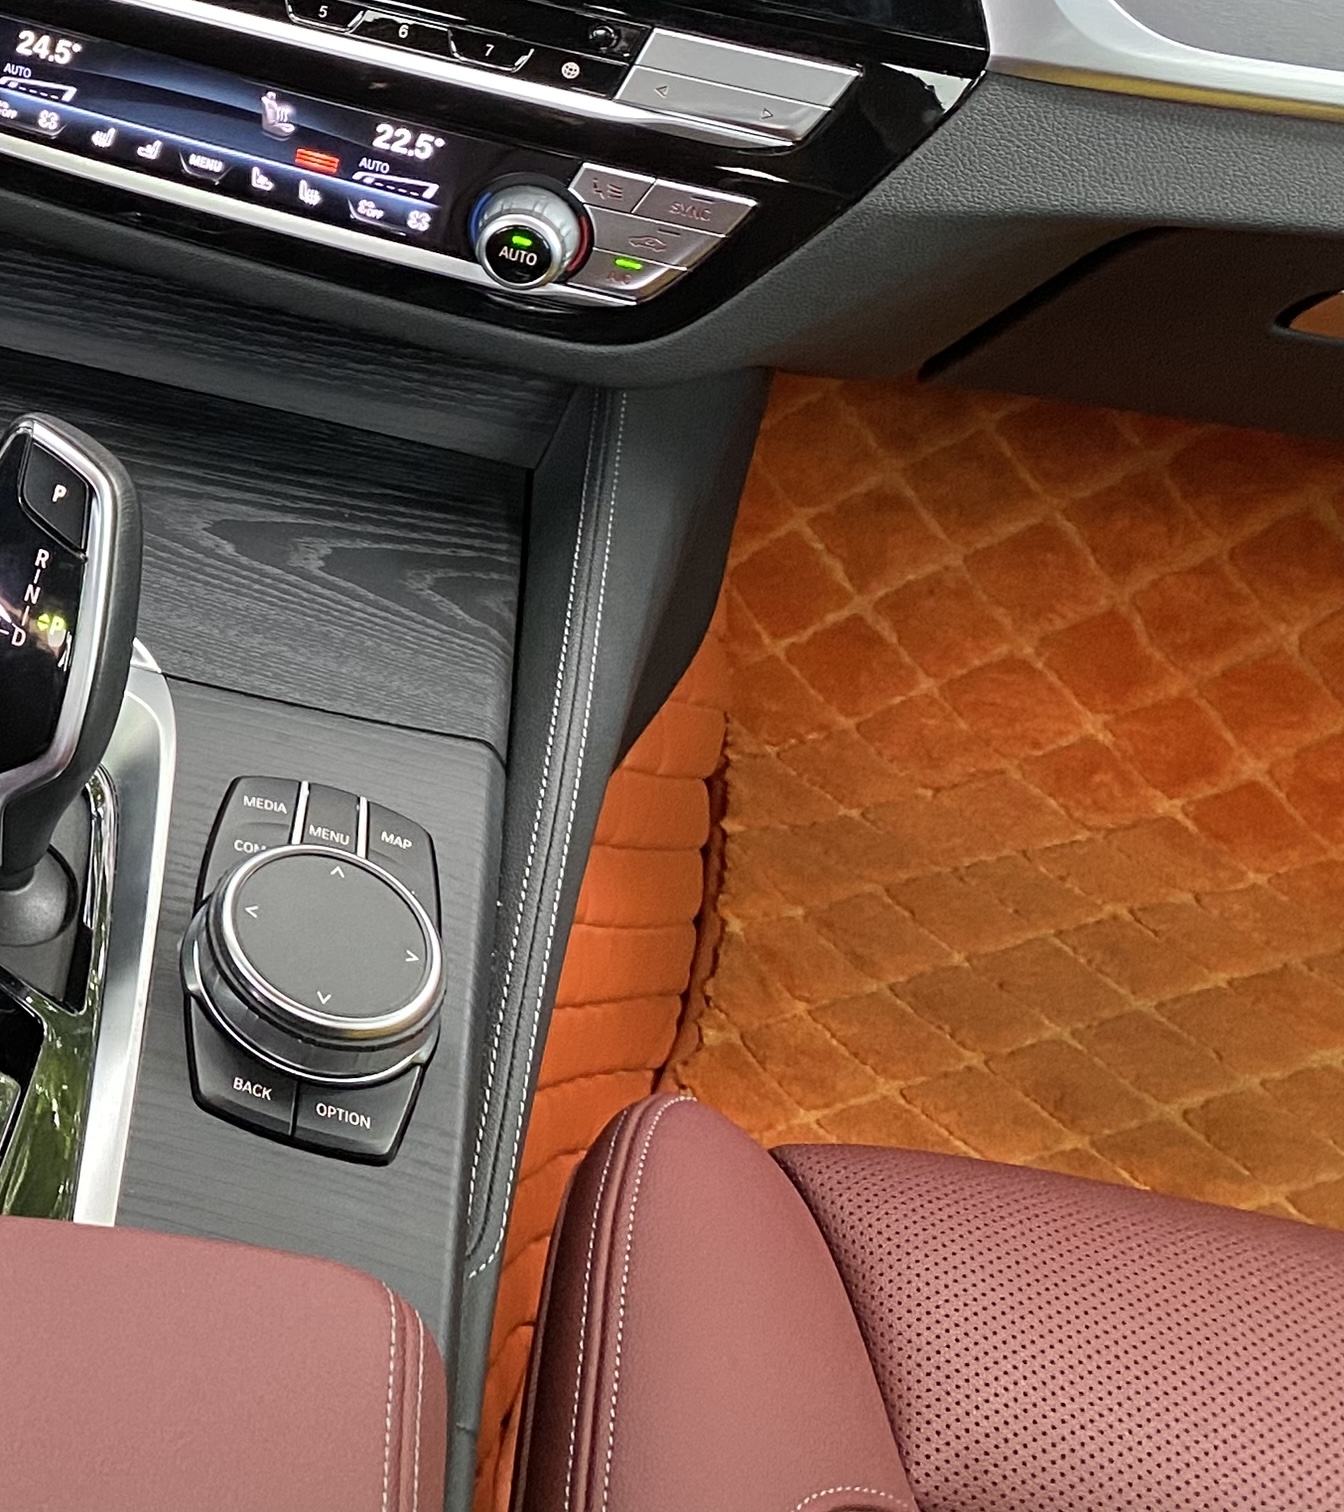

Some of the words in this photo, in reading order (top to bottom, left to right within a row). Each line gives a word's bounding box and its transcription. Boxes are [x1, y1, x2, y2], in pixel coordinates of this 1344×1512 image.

[318, 5, 328, 18] 5
[398, 24, 409, 38] 6
[15, 29, 83, 65] 24.5°
[485, 43, 495, 57] 7
[3, 62, 32, 79] AUTO
[372, 123, 446, 160] 22.5°
[188, 154, 224, 173] MENU
[358, 157, 390, 174] AUTO
[668, 202, 712, 223] SYNC
[498, 245, 538, 266] AUTO
[52, 484, 67, 503] P
[34, 548, 50, 569] R
[24, 584, 41, 605] N
[11, 623, 27, 647] D
[48, 615, 67, 636] P
[243, 795, 288, 815] MEDIA
[308, 824, 350, 846] MENU
[380, 830, 413, 850] MAP
[233, 1076, 273, 1101] BACK
[315, 1102, 372, 1130] OPTION
